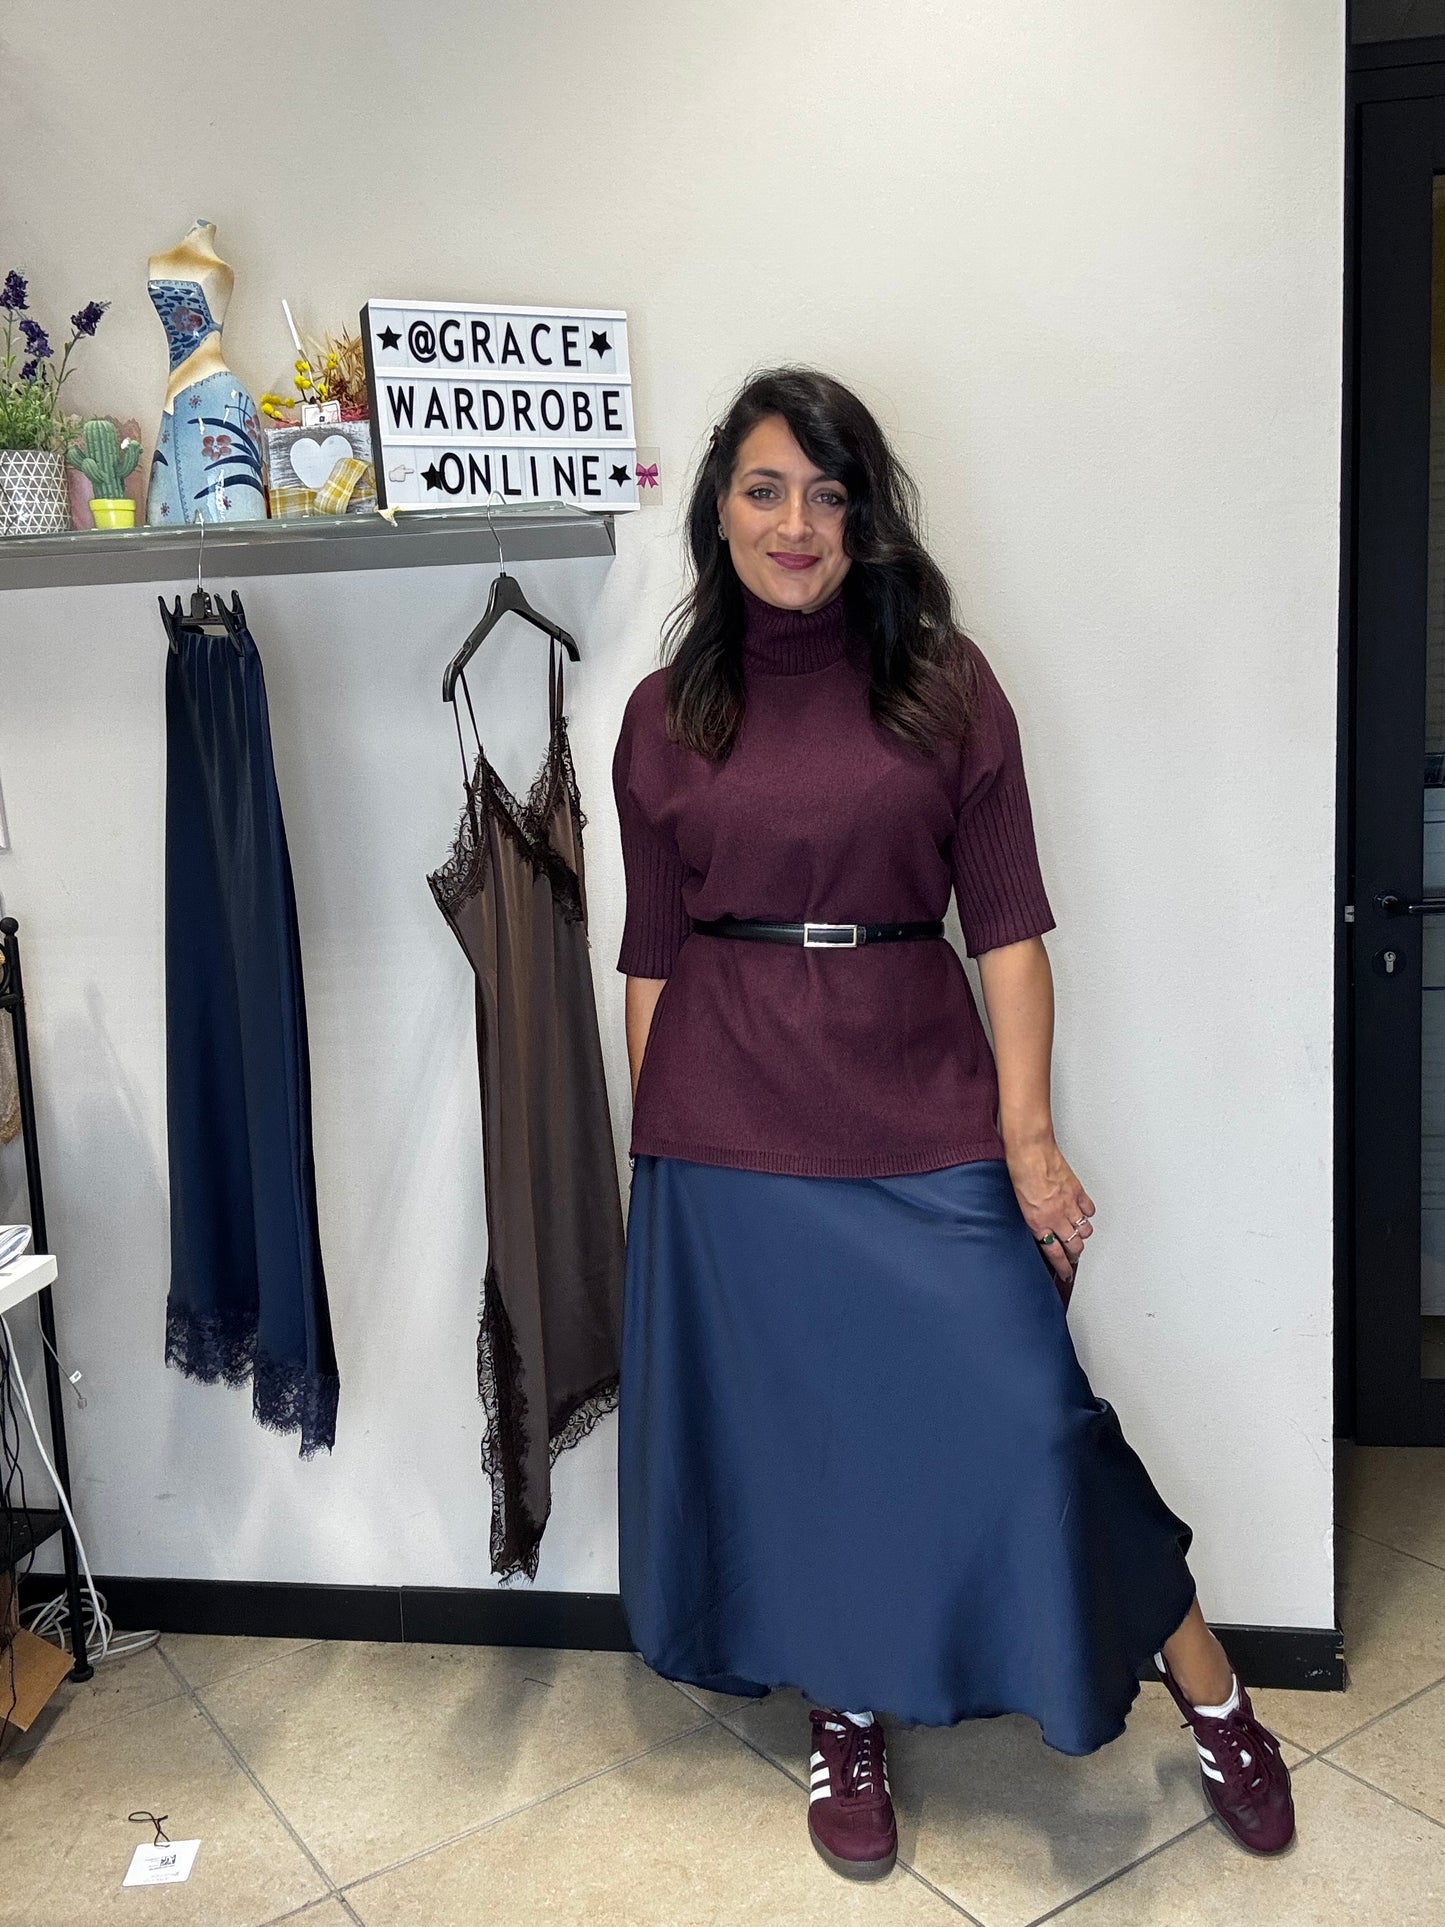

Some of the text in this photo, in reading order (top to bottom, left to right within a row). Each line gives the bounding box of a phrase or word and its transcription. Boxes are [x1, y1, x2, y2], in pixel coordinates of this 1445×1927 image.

[408, 319, 582, 367] @GRACE
[387, 385, 623, 432] WARDROBE
[439, 452, 602, 496] ONLINE
